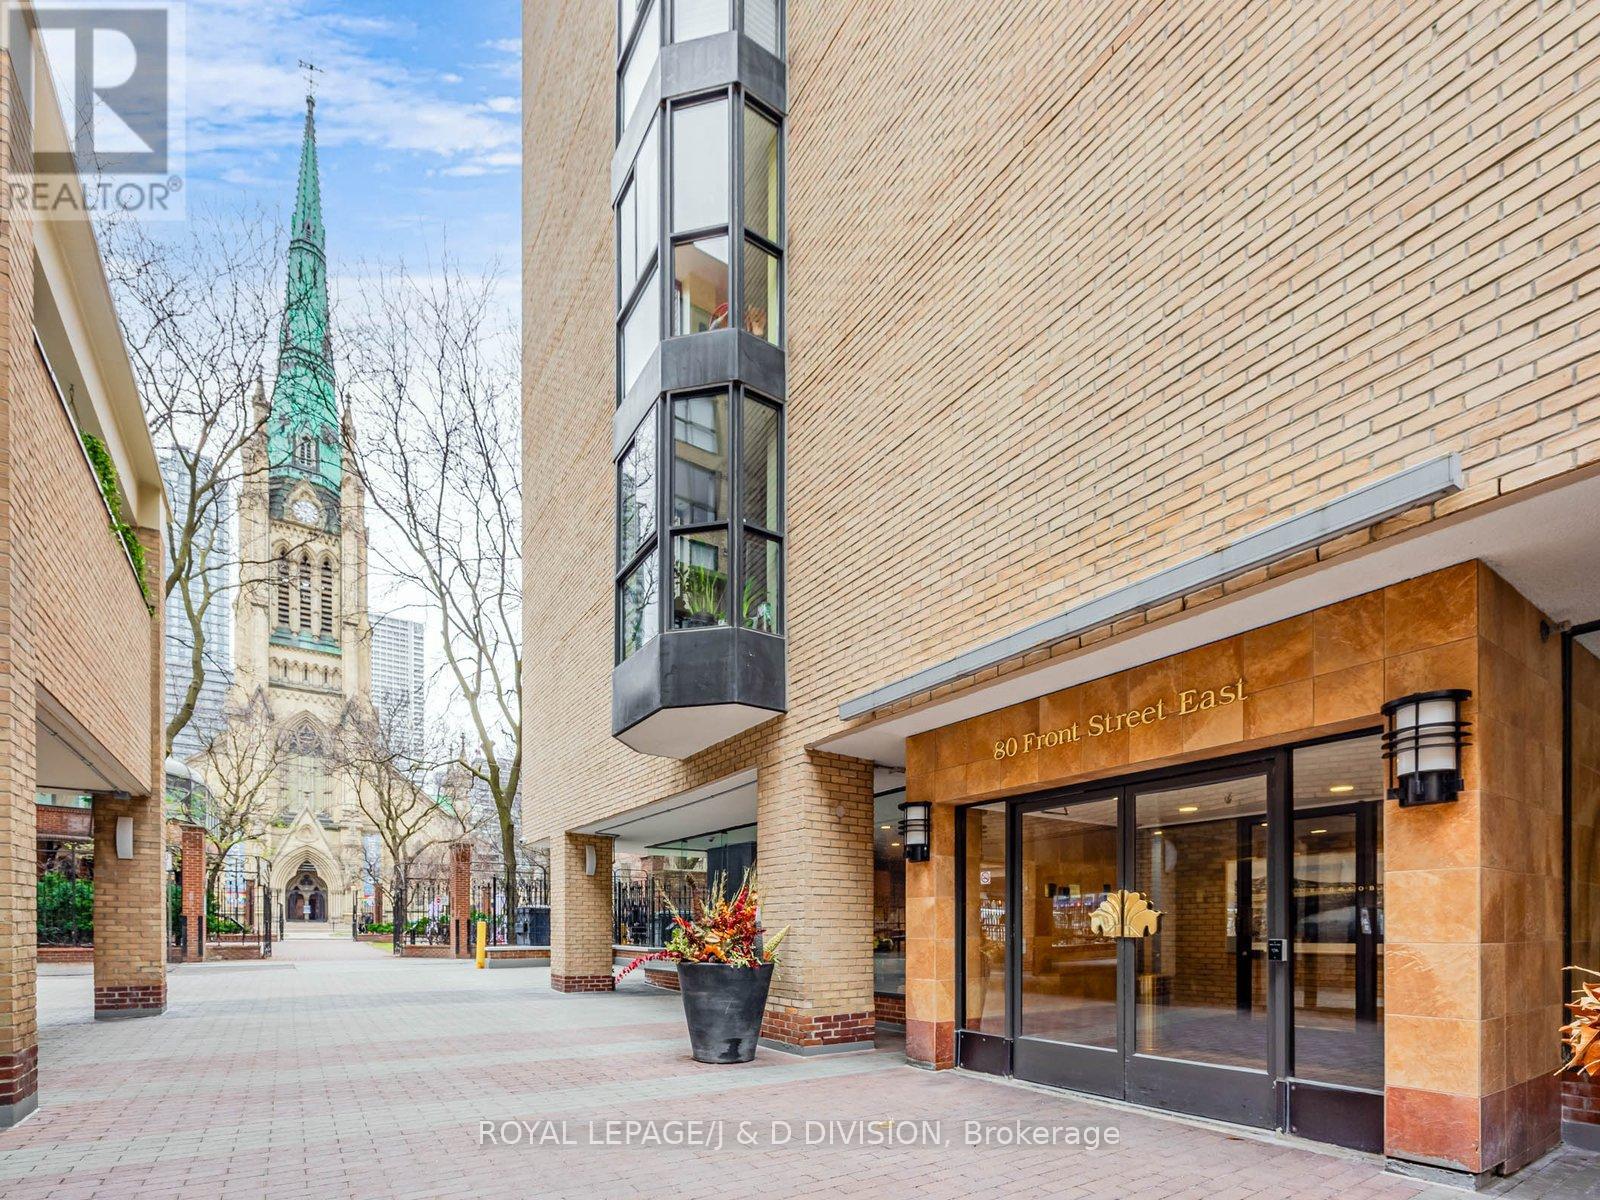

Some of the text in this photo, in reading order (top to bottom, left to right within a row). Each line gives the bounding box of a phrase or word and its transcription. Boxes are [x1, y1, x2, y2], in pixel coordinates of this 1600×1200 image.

[993, 677, 1248, 760] 80 Front Street East
